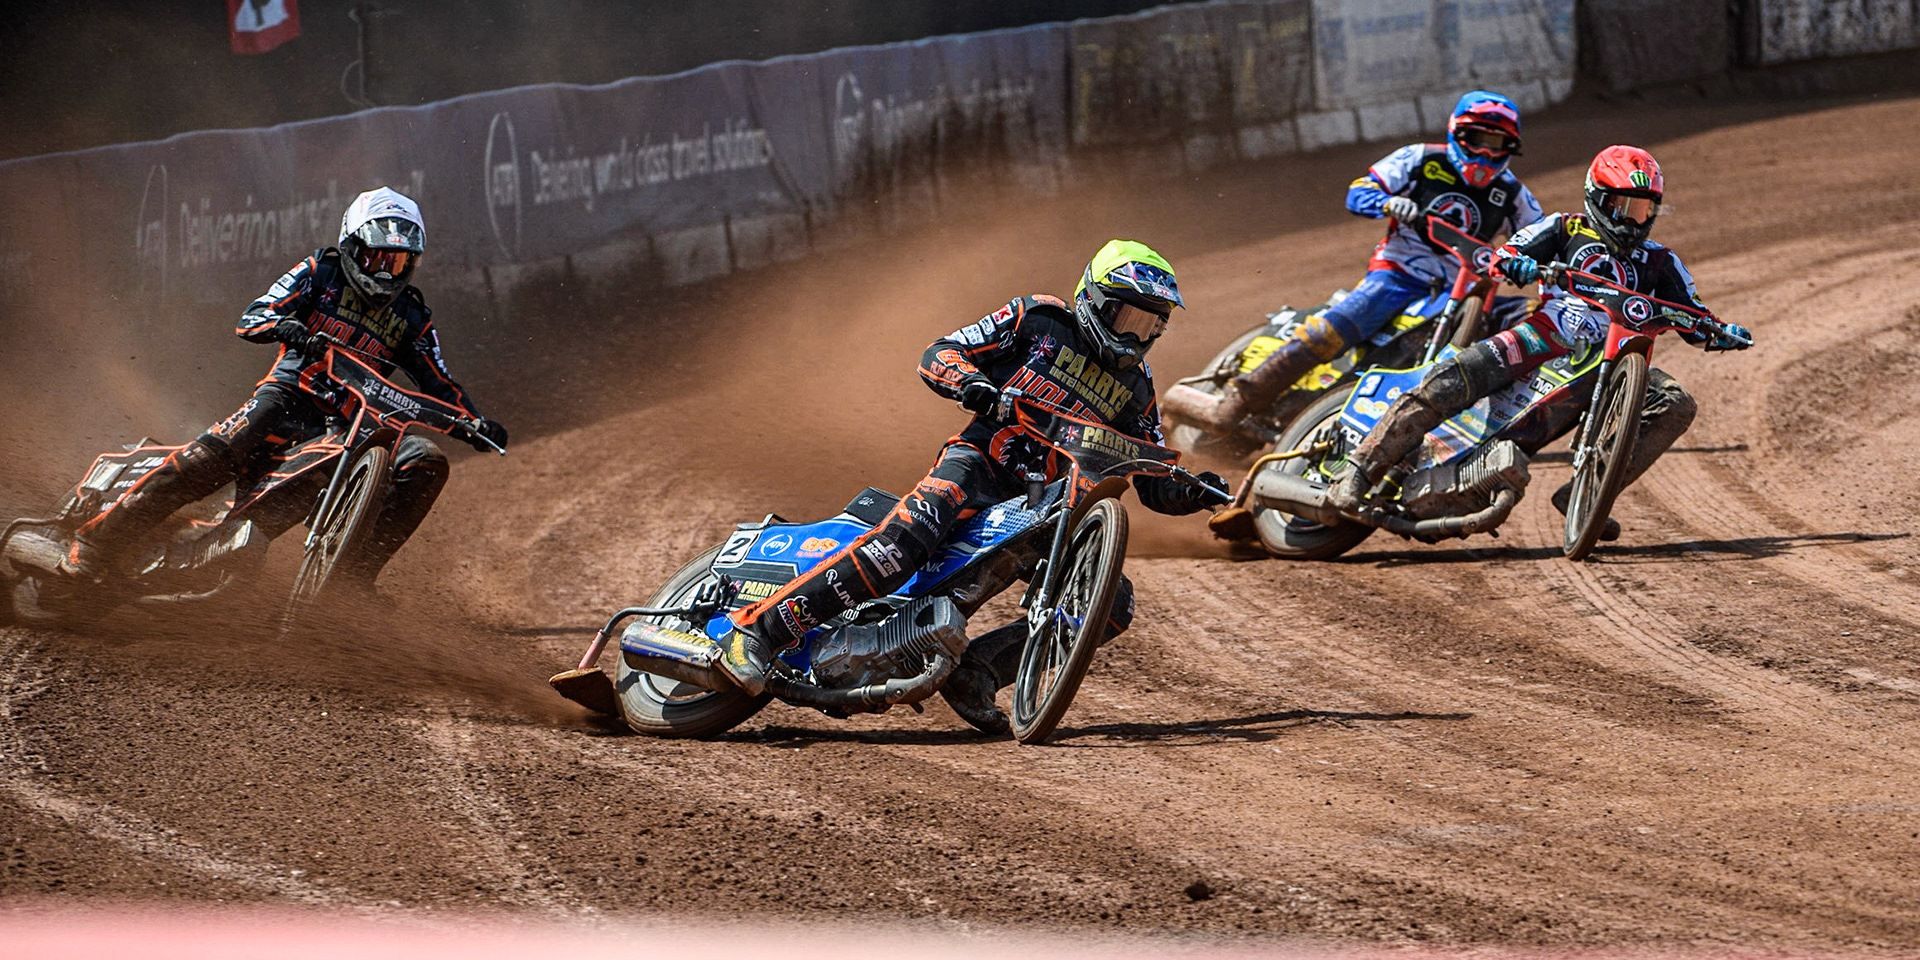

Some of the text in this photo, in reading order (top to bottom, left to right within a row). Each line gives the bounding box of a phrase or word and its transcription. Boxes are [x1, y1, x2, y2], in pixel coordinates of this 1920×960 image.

[531, 149, 594, 212] Delivering
[1055, 345, 1133, 413] PARRYS
[380, 385, 422, 414] PARRYS
[1083, 426, 1140, 460] PARRYS
[722, 537, 751, 557] 2
[866, 543, 887, 563] ROCK
[883, 562, 896, 576] OIL
